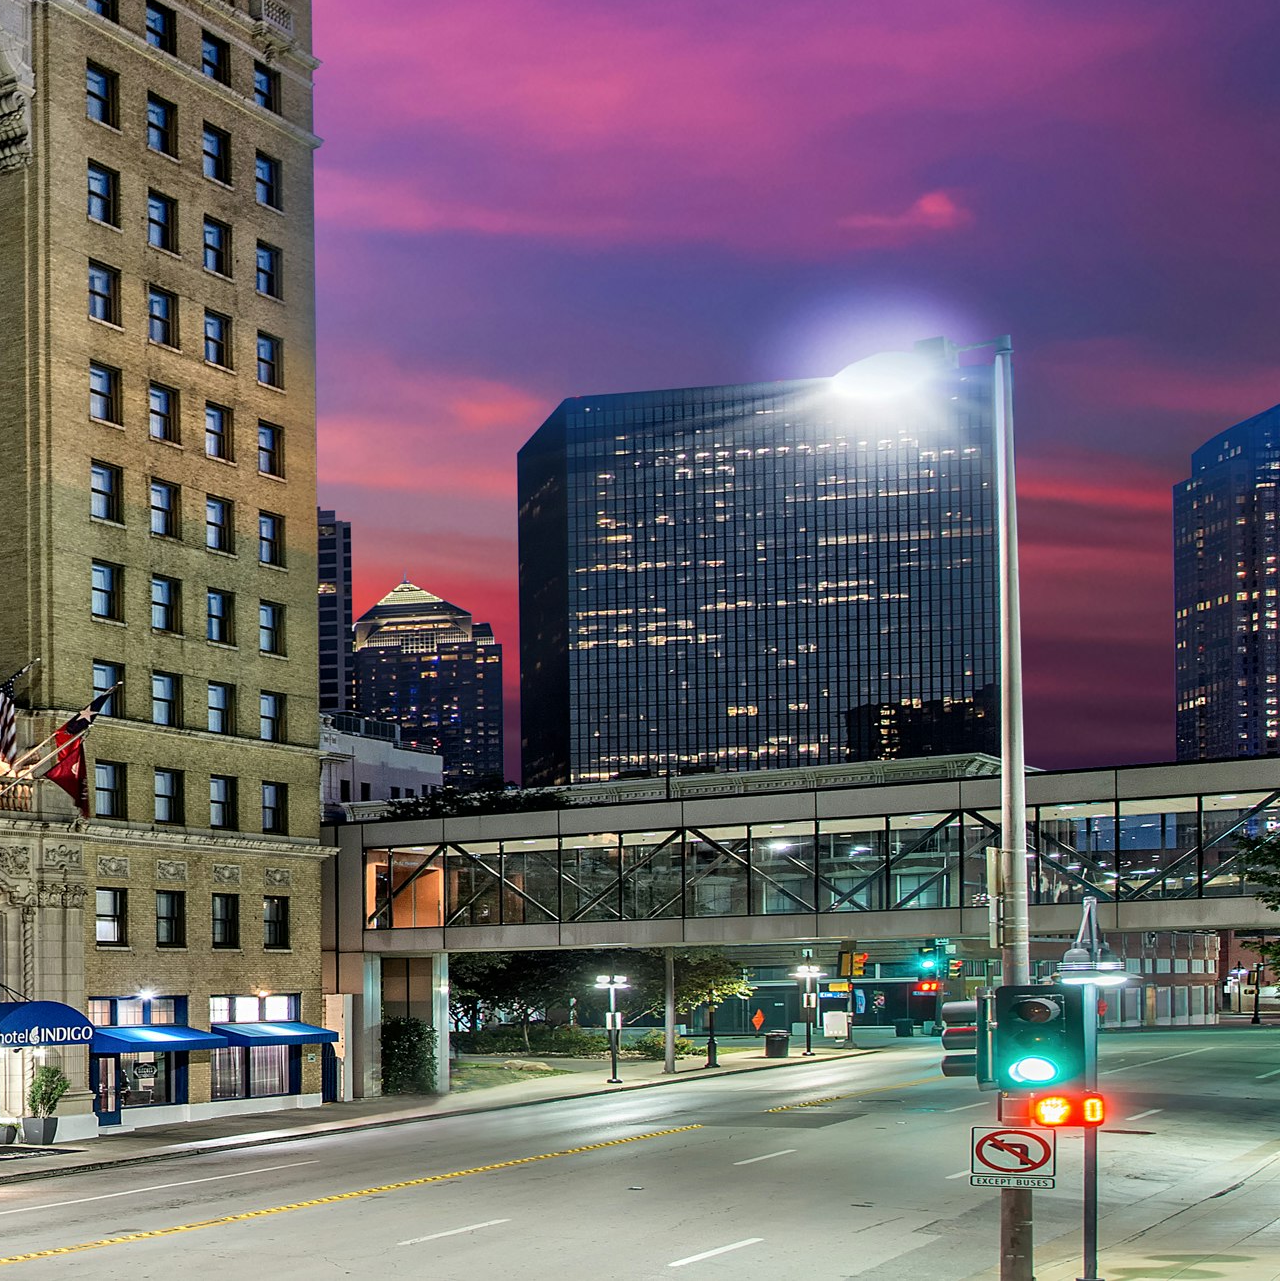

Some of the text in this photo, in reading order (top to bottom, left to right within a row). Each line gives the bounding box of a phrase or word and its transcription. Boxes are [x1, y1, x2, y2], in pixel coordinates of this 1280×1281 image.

[41, 1026, 93, 1042] INDIGO
[1084, 1098, 1103, 1122] 0
[977, 1177, 1048, 1187] EXCEPT BUSES
